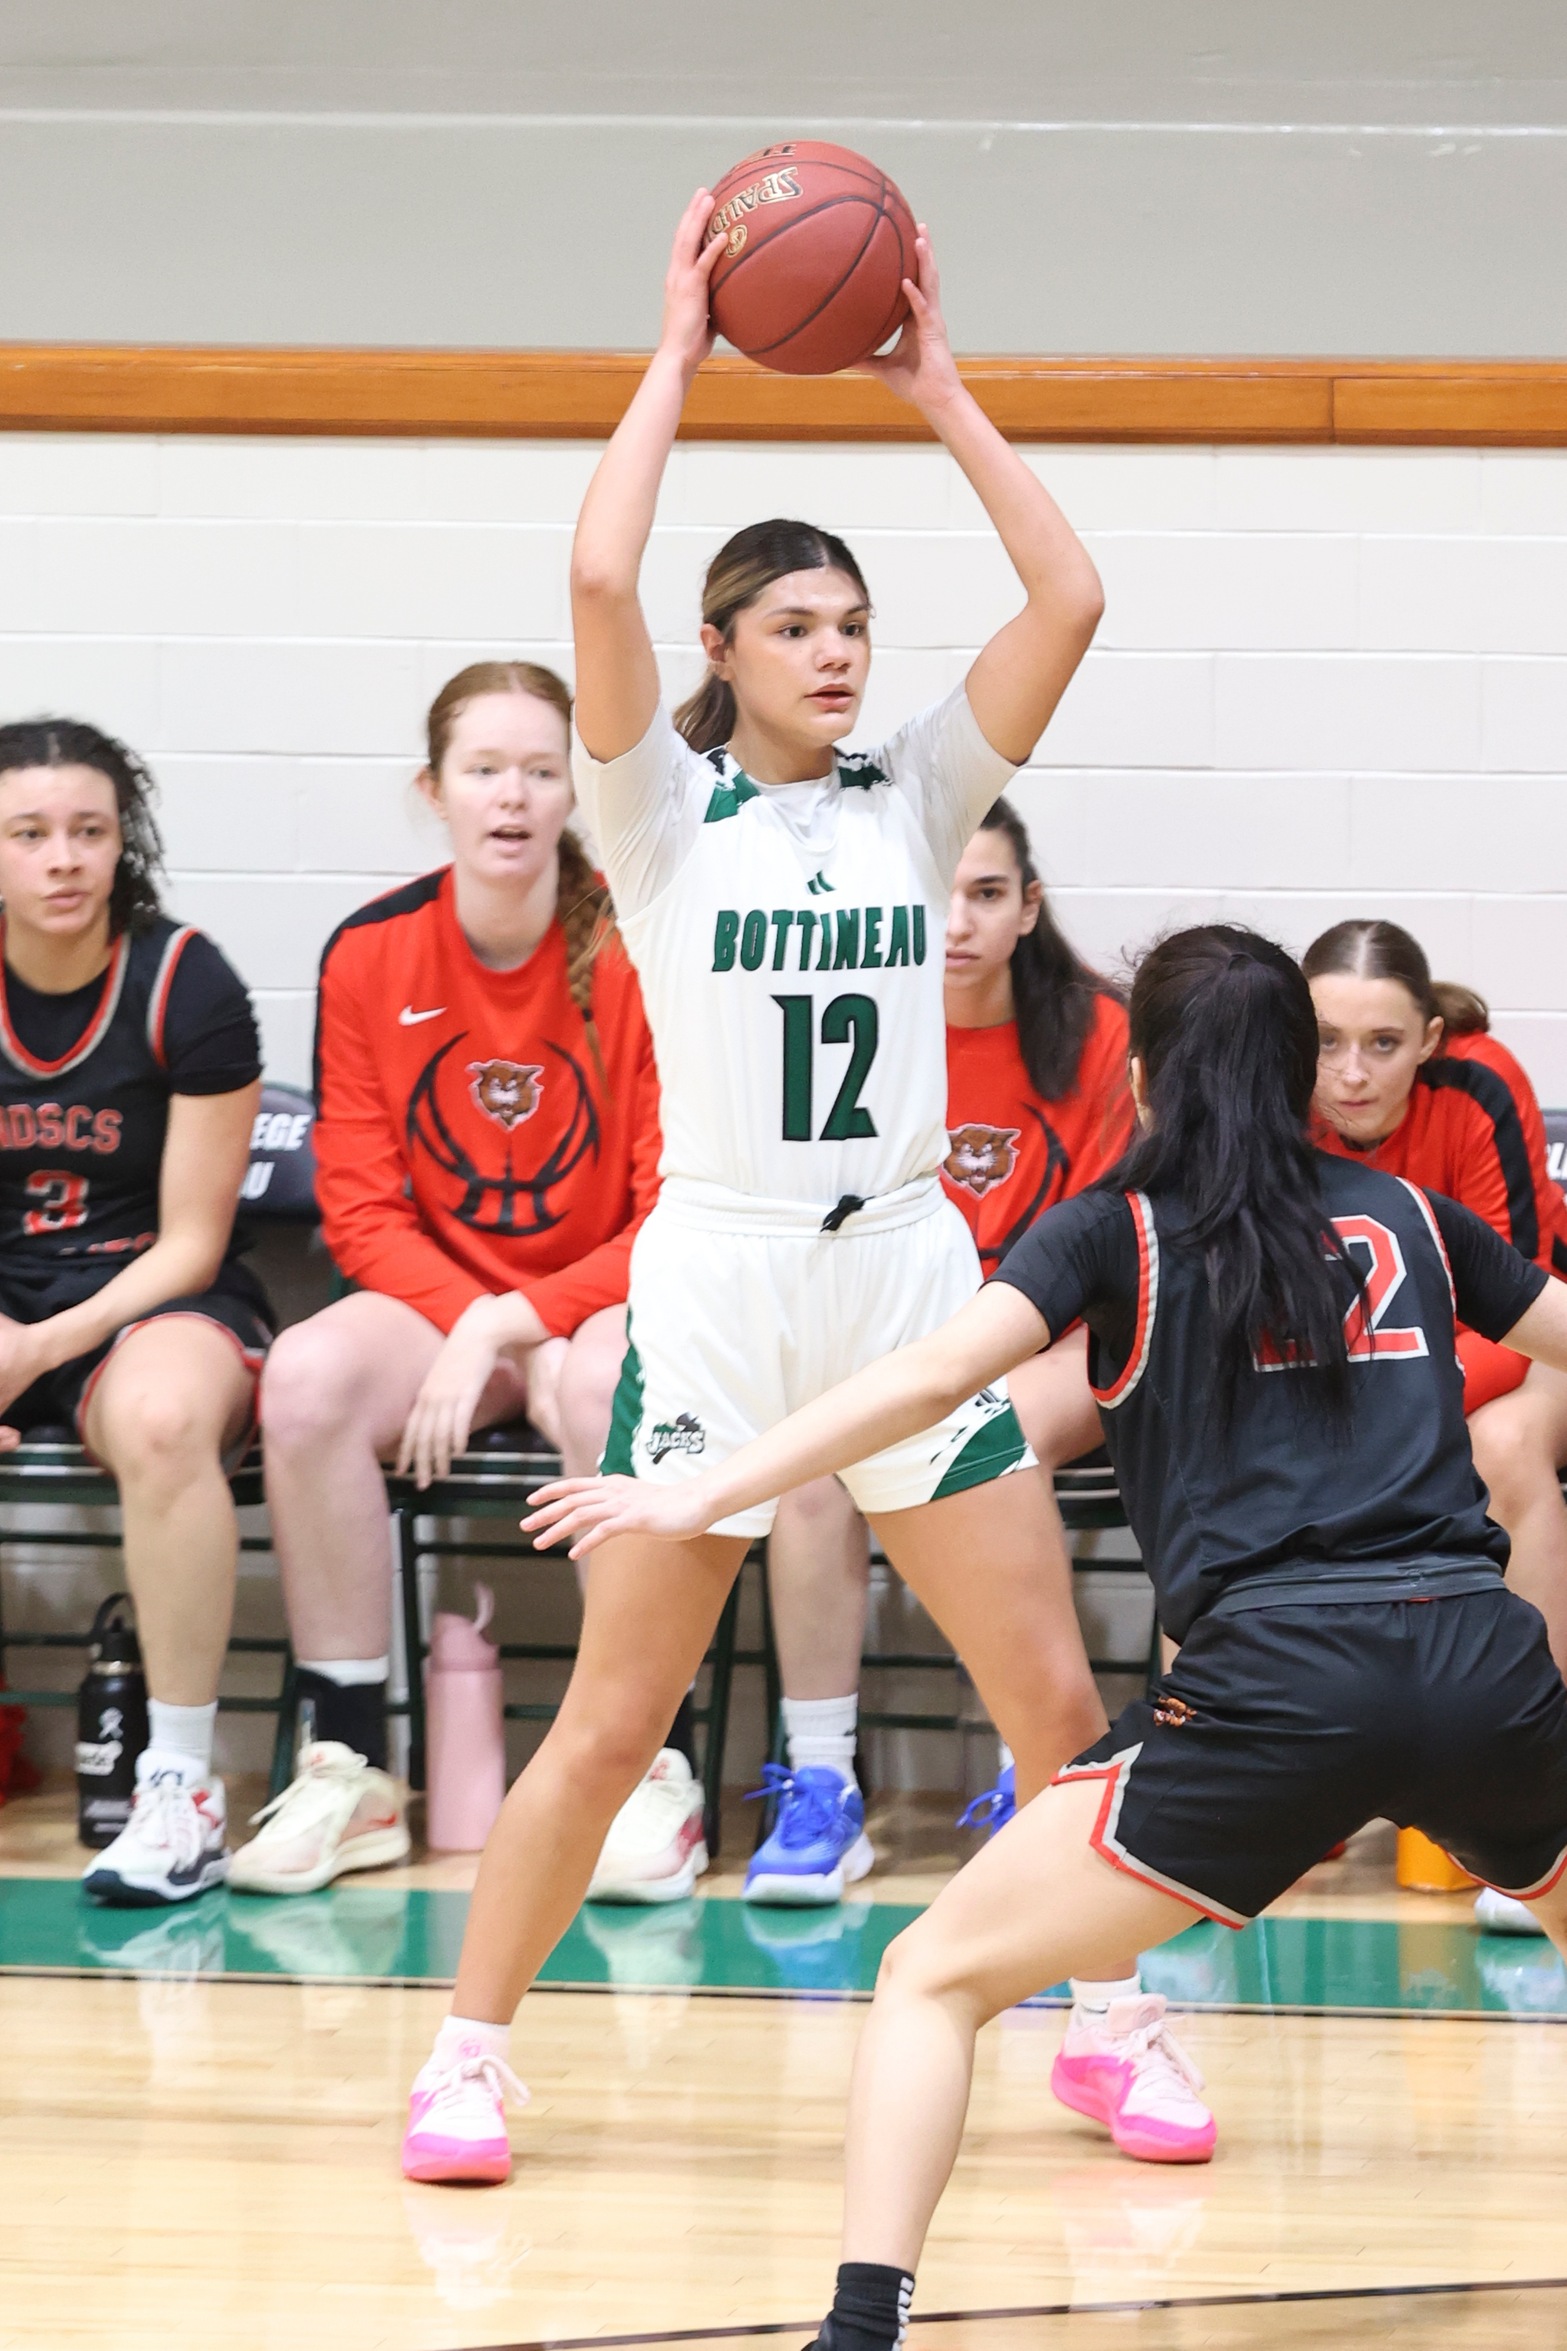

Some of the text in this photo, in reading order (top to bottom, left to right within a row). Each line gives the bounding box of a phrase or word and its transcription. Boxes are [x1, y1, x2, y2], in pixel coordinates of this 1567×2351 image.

[711, 904, 927, 972] BOTTINEAU
[769, 993, 880, 1142] 12
[23, 1169, 90, 1236] 3
[1252, 1213, 1430, 1373] 2
[645, 1428, 706, 1456] JACKS
